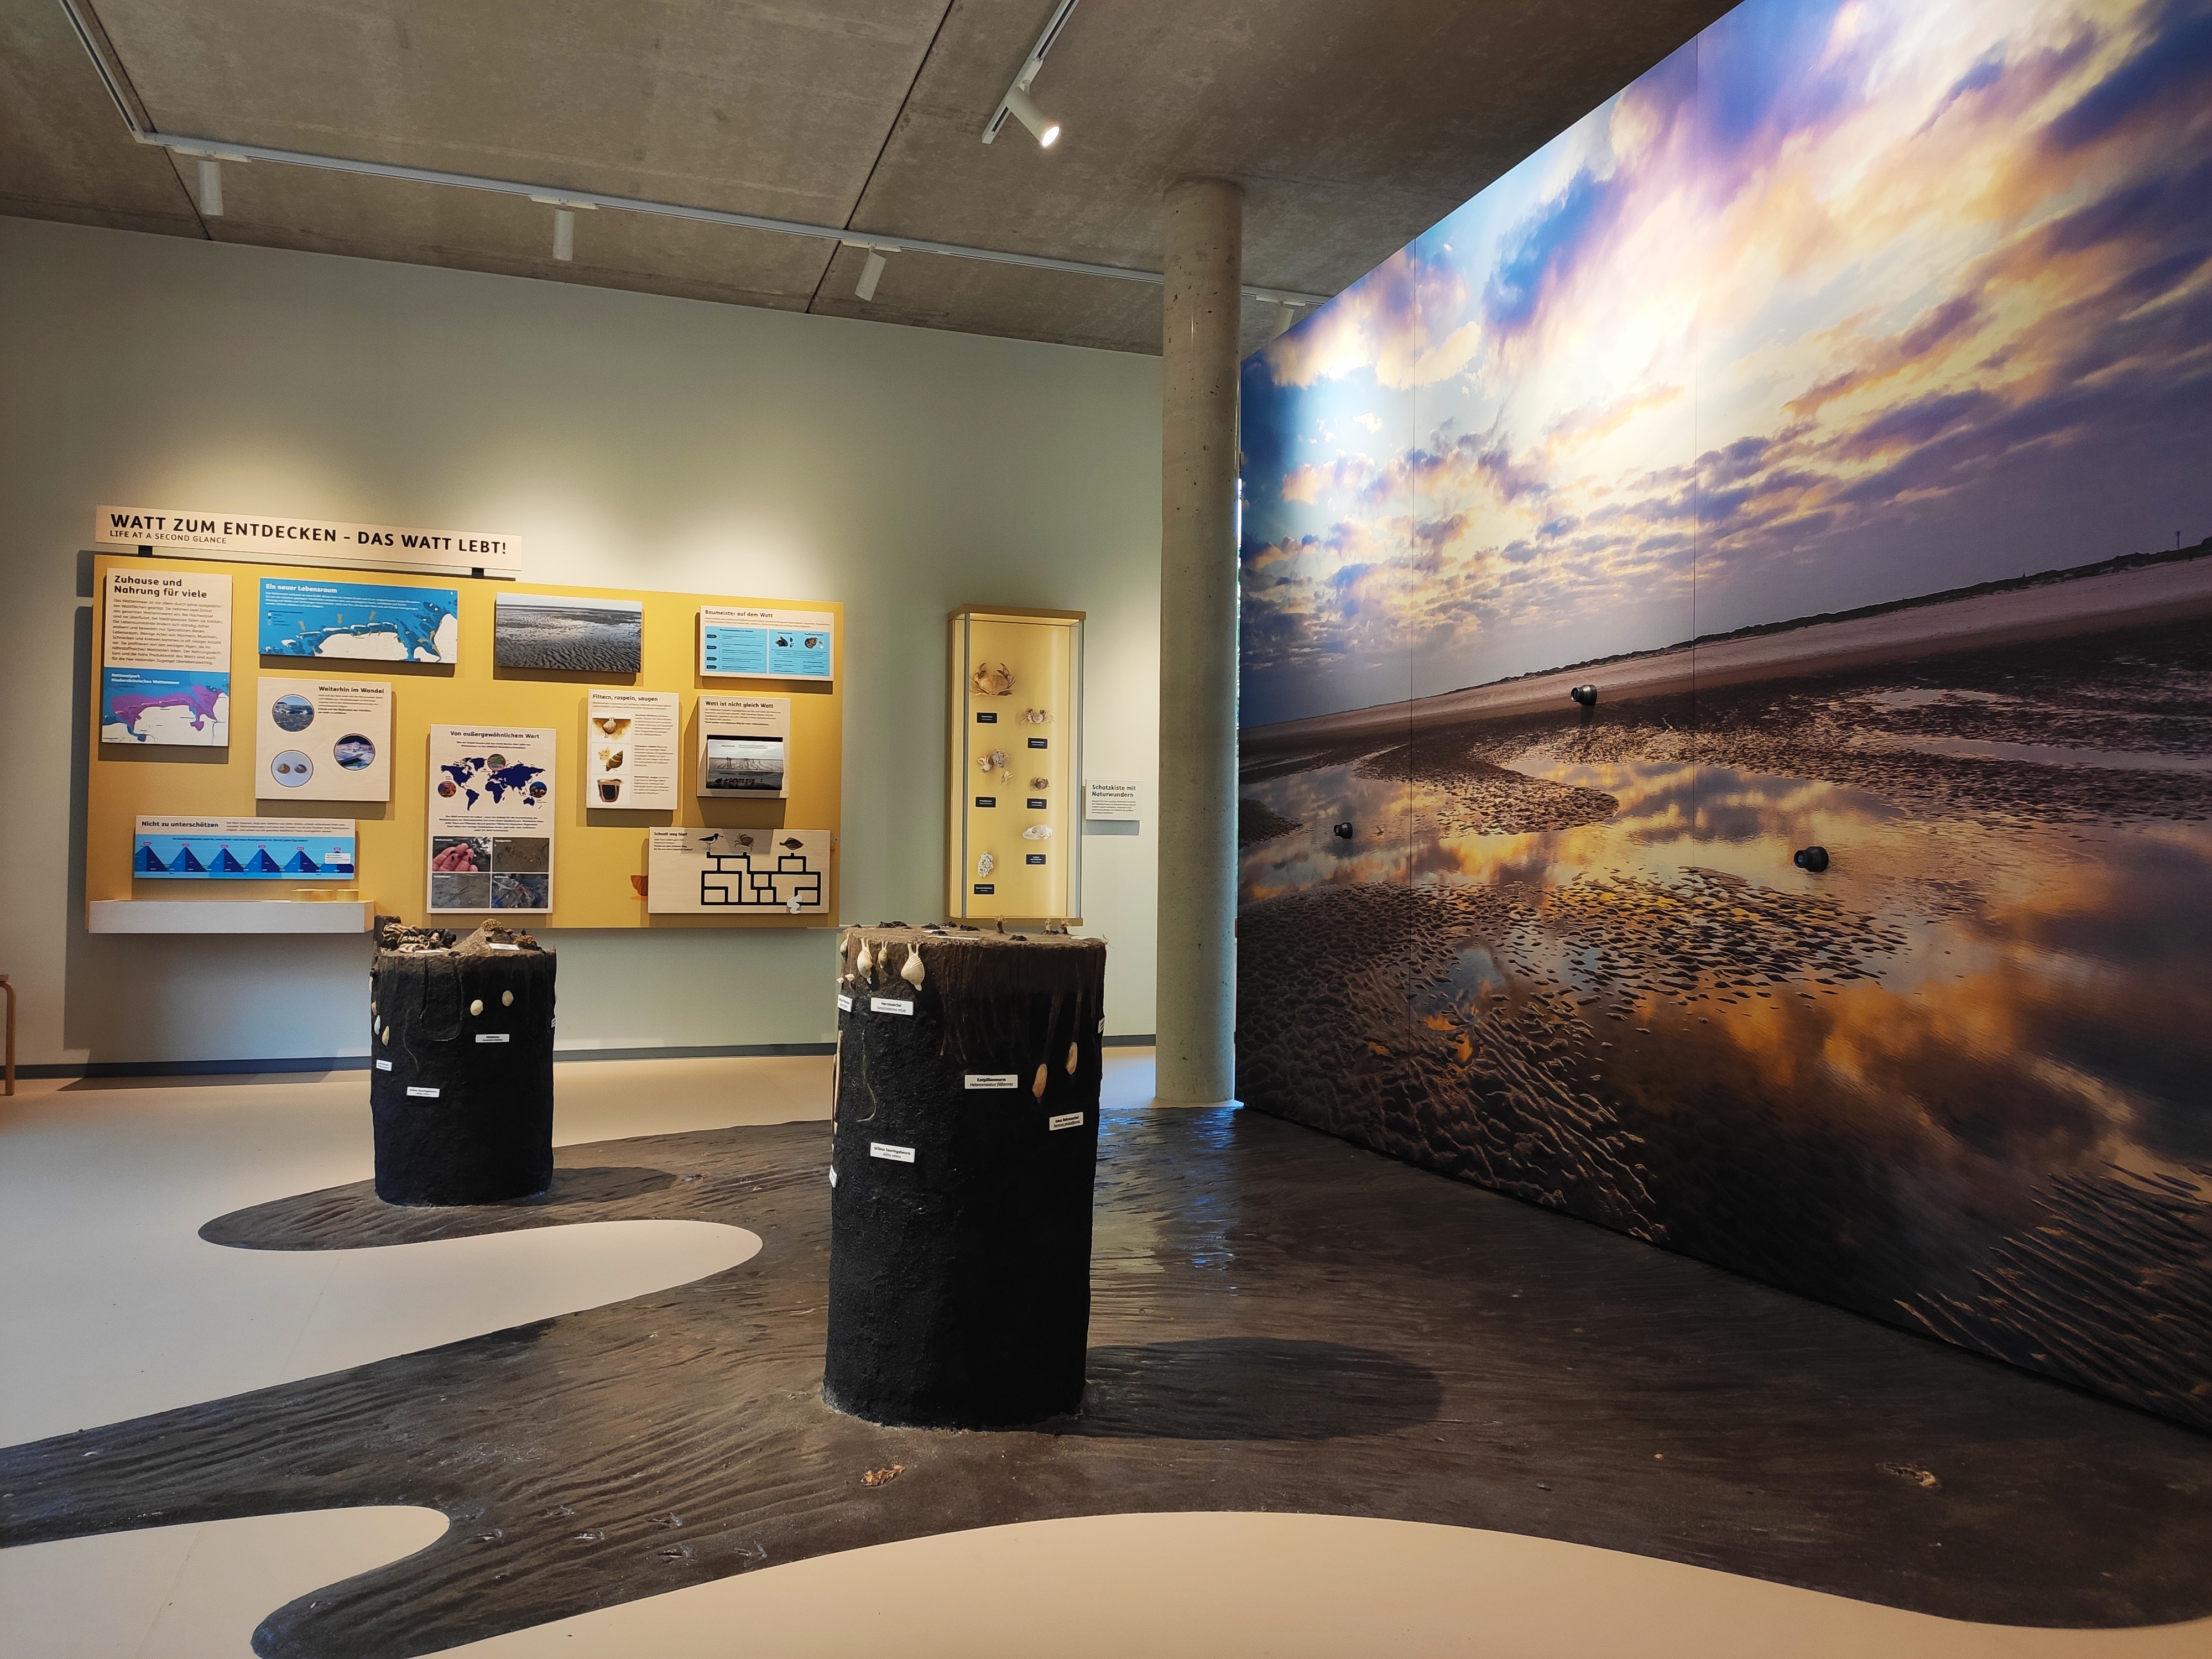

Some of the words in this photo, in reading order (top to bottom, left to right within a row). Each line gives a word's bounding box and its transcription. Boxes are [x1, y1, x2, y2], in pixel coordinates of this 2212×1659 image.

[111, 514, 166, 530] WATT
[173, 518, 215, 534] ZUM
[223, 521, 337, 542] ENTDECKEN
[358, 531, 394, 546] DAS
[401, 534, 452, 550] WATT
[458, 539, 507, 554] LEBT!
[154, 533, 190, 541] SECOND
[192, 535, 227, 544] GLANCE
[114, 575, 159, 586] Zuhause
[163, 578, 182, 587] und
[114, 585, 160, 597] Nahrung
[163, 587, 178, 597] für
[181, 589, 207, 598] viele
